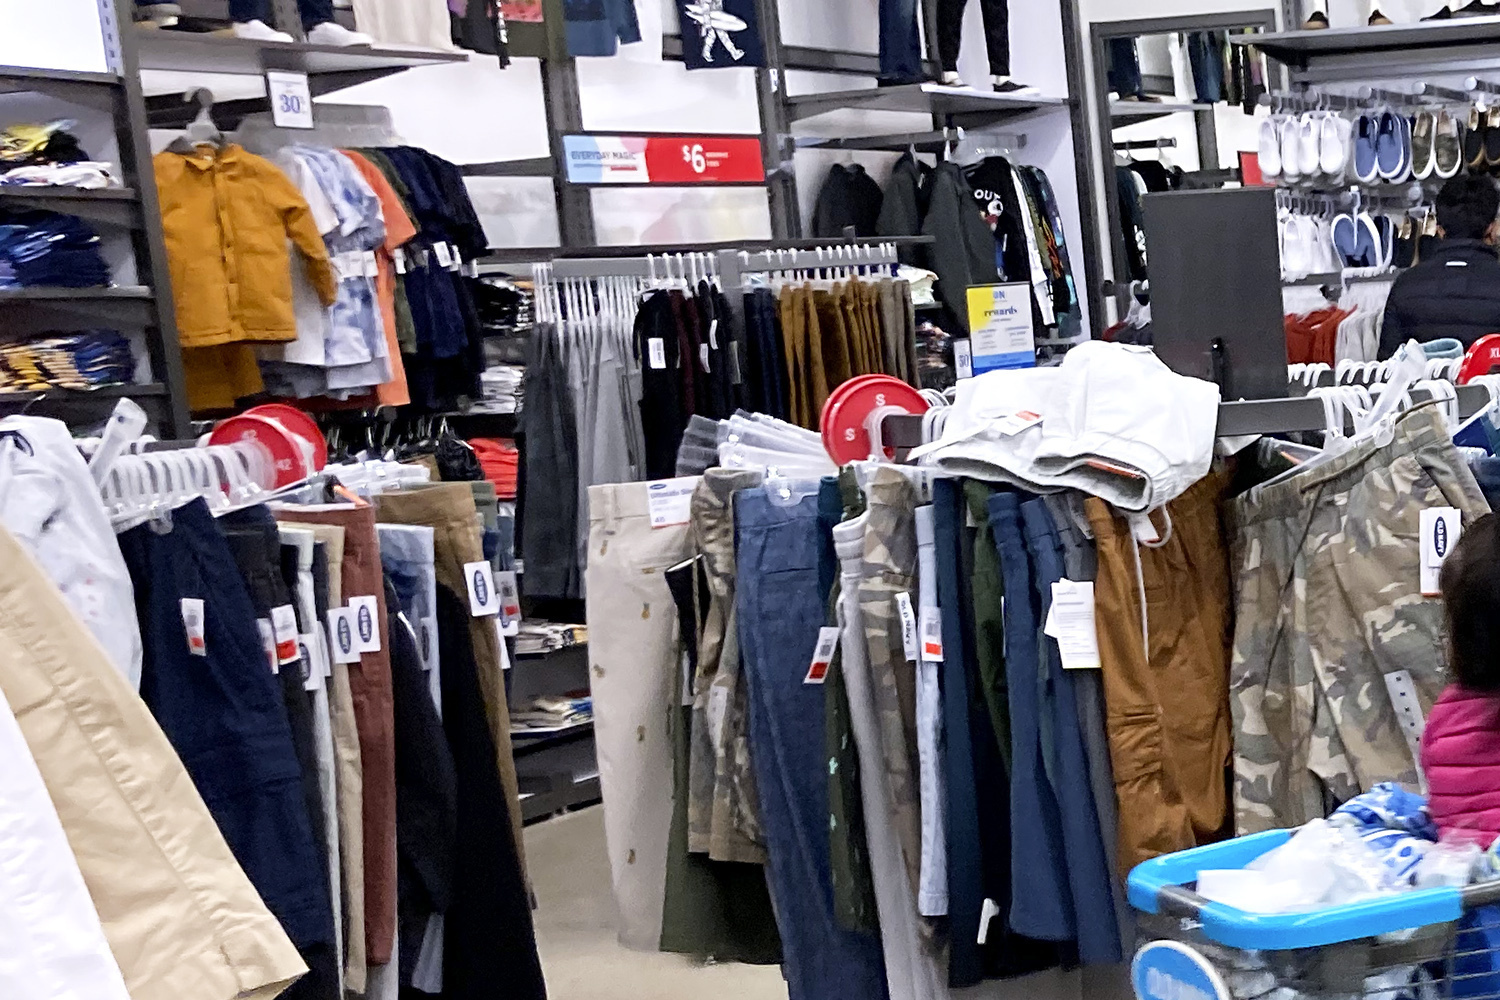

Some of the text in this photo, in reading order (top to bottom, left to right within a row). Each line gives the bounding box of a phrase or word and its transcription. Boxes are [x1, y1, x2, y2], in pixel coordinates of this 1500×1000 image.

[682, 144, 706, 173] $6
[875, 393, 886, 406] S
[845, 428, 855, 441] S
